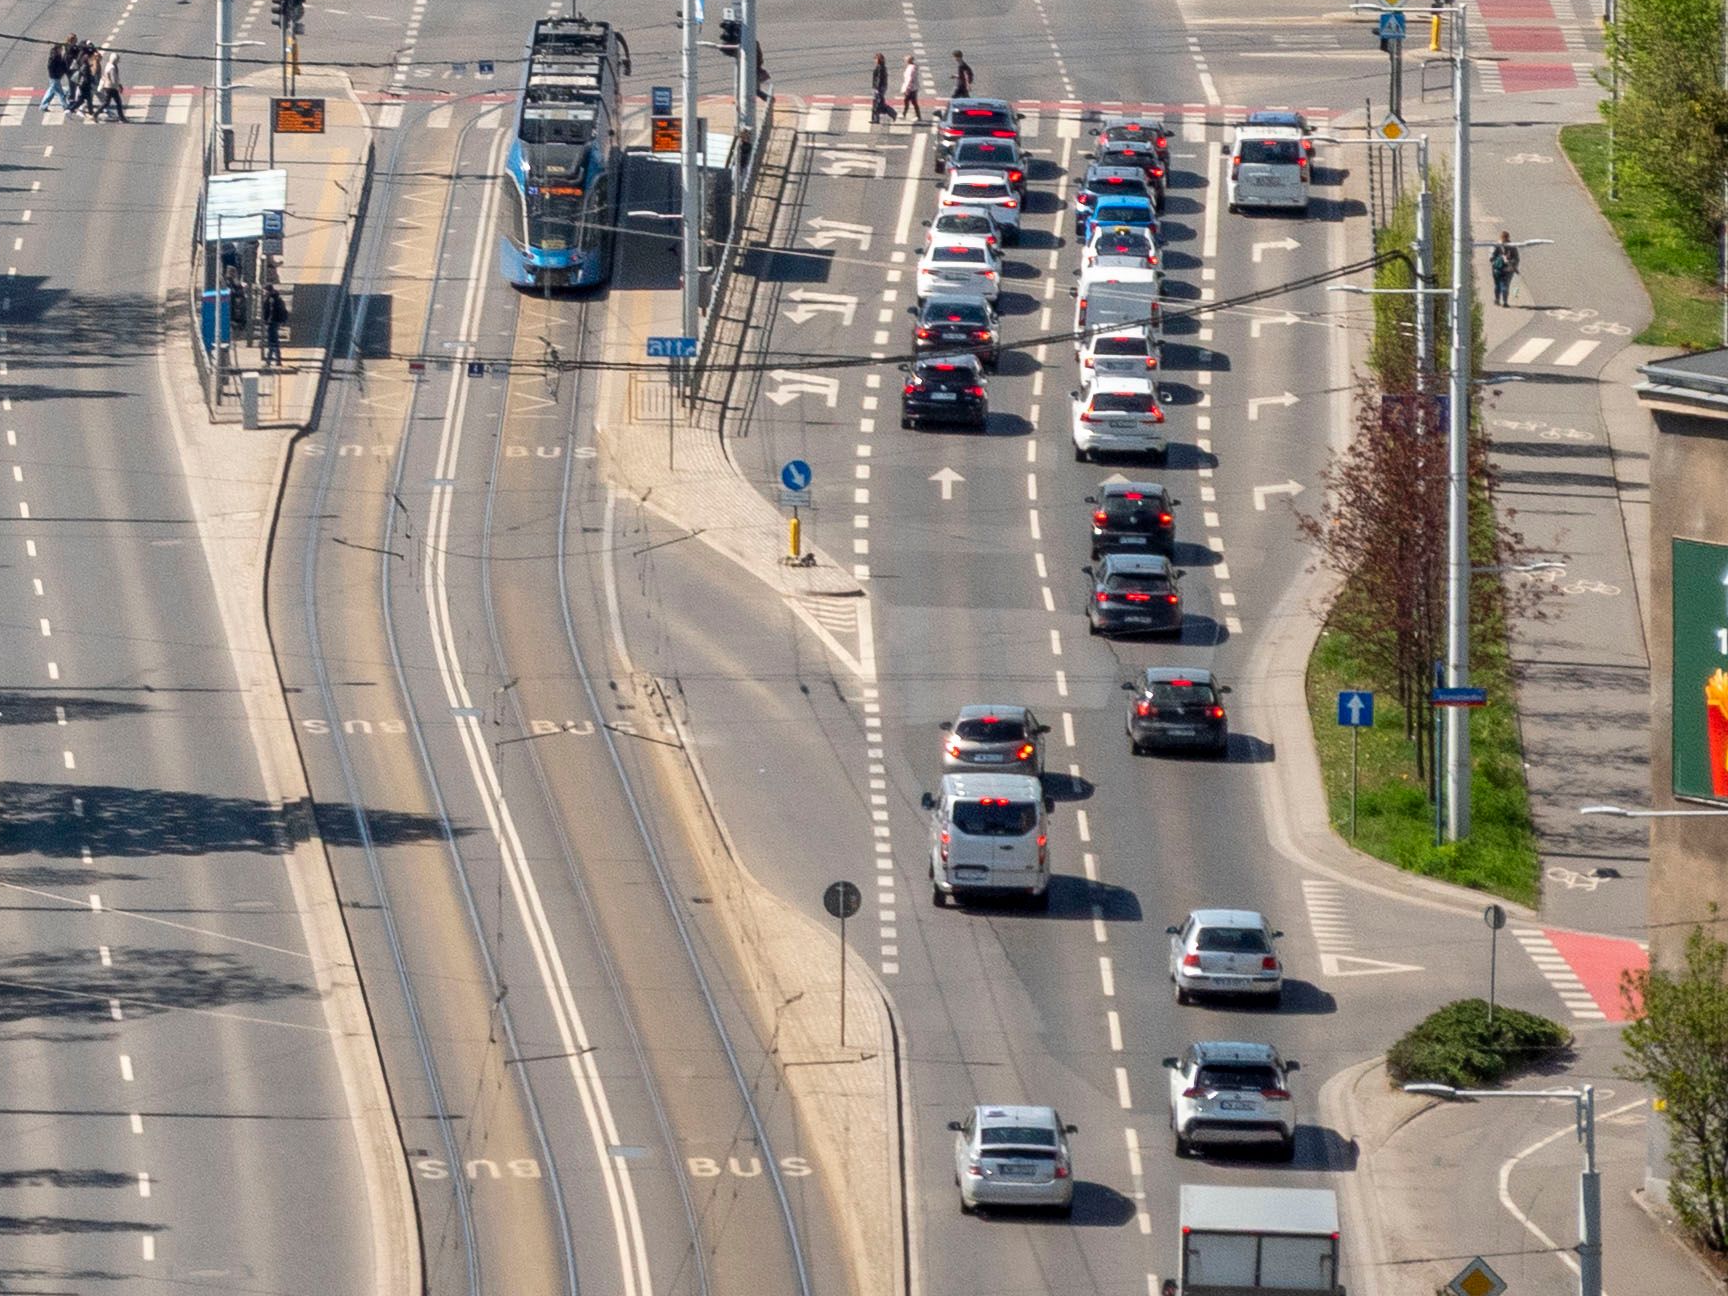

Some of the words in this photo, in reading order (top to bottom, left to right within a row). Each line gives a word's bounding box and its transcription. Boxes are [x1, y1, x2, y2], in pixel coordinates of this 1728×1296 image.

[505, 444, 598, 459] BUS
[416, 1157, 542, 1180] BUS
[687, 1156, 814, 1178] BUS
